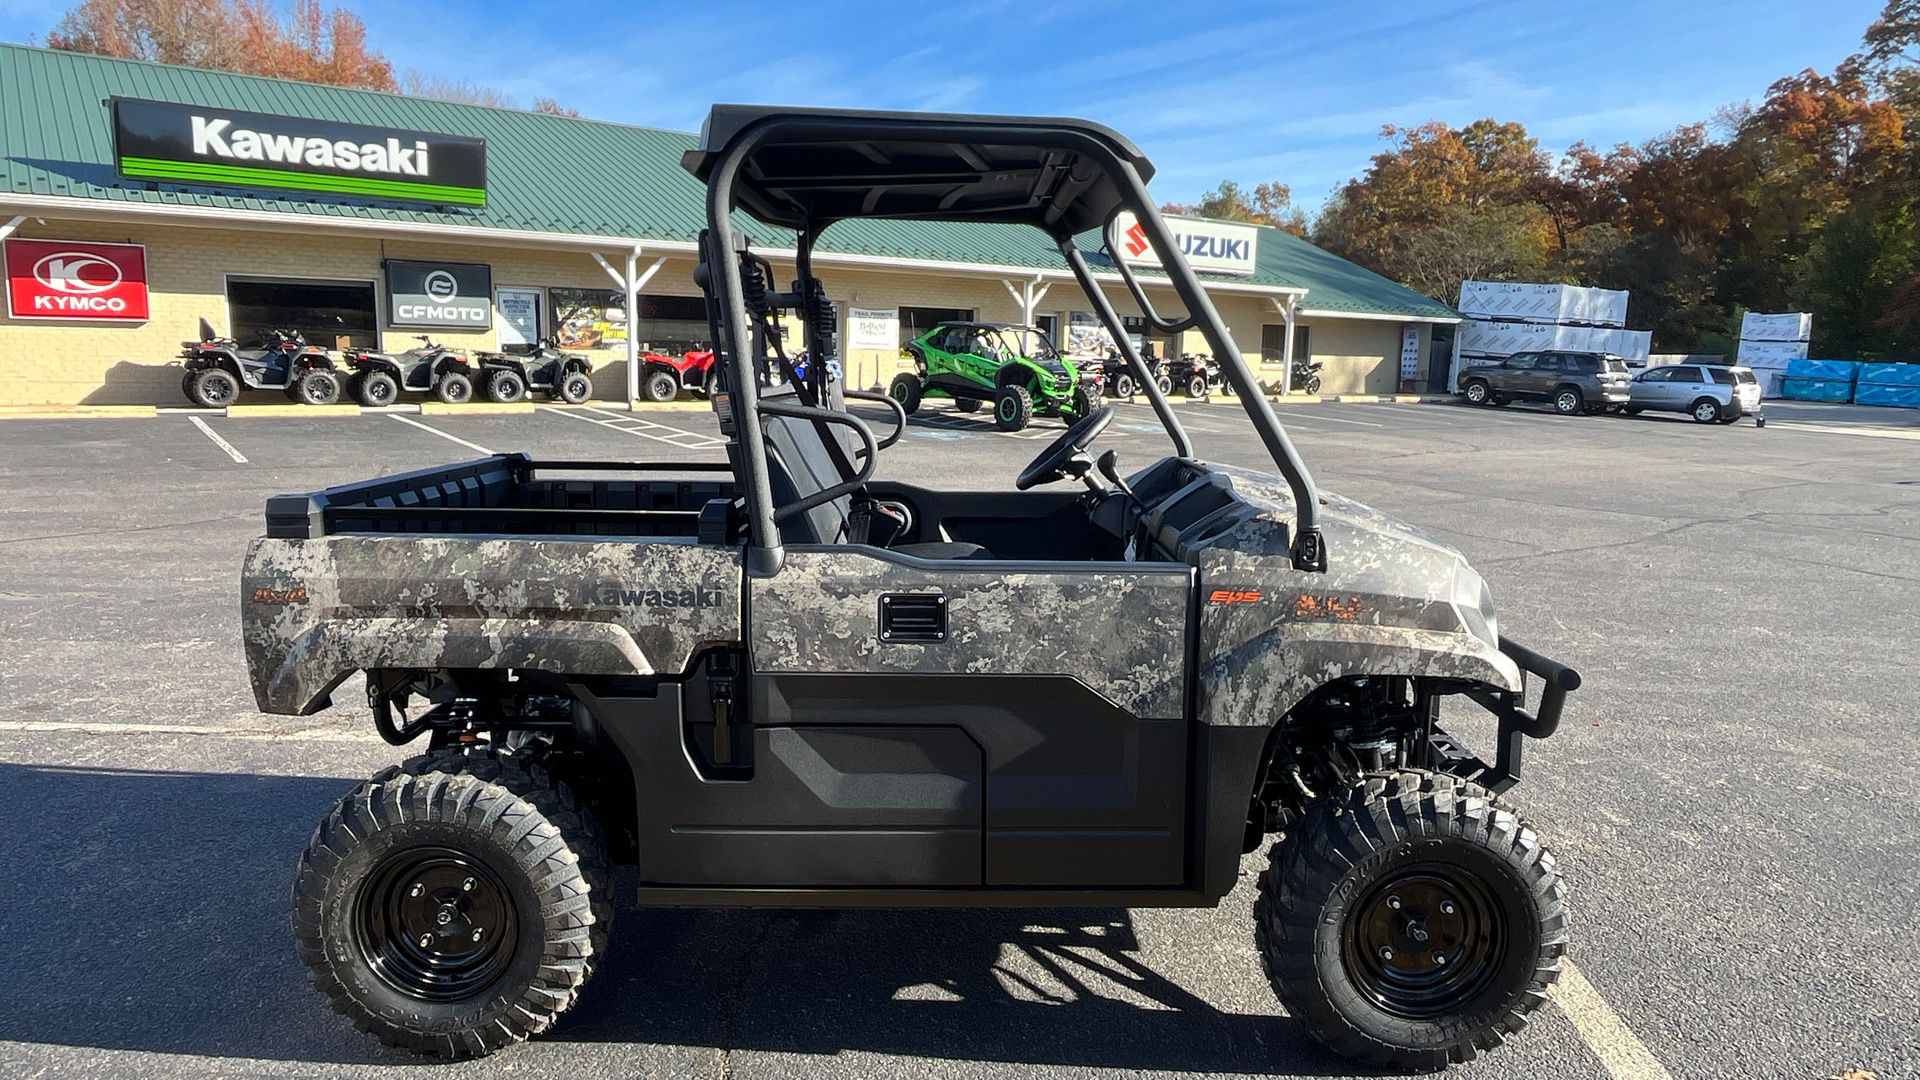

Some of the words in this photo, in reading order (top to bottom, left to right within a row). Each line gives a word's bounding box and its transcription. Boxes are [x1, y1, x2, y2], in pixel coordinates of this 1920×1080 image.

[191, 115, 429, 176] Kawasaki
[1174, 232, 1250, 260] UZUKI
[34, 295, 126, 312] KYMCO
[398, 304, 486, 321] CFMOTO
[581, 583, 722, 607] Kawasaki
